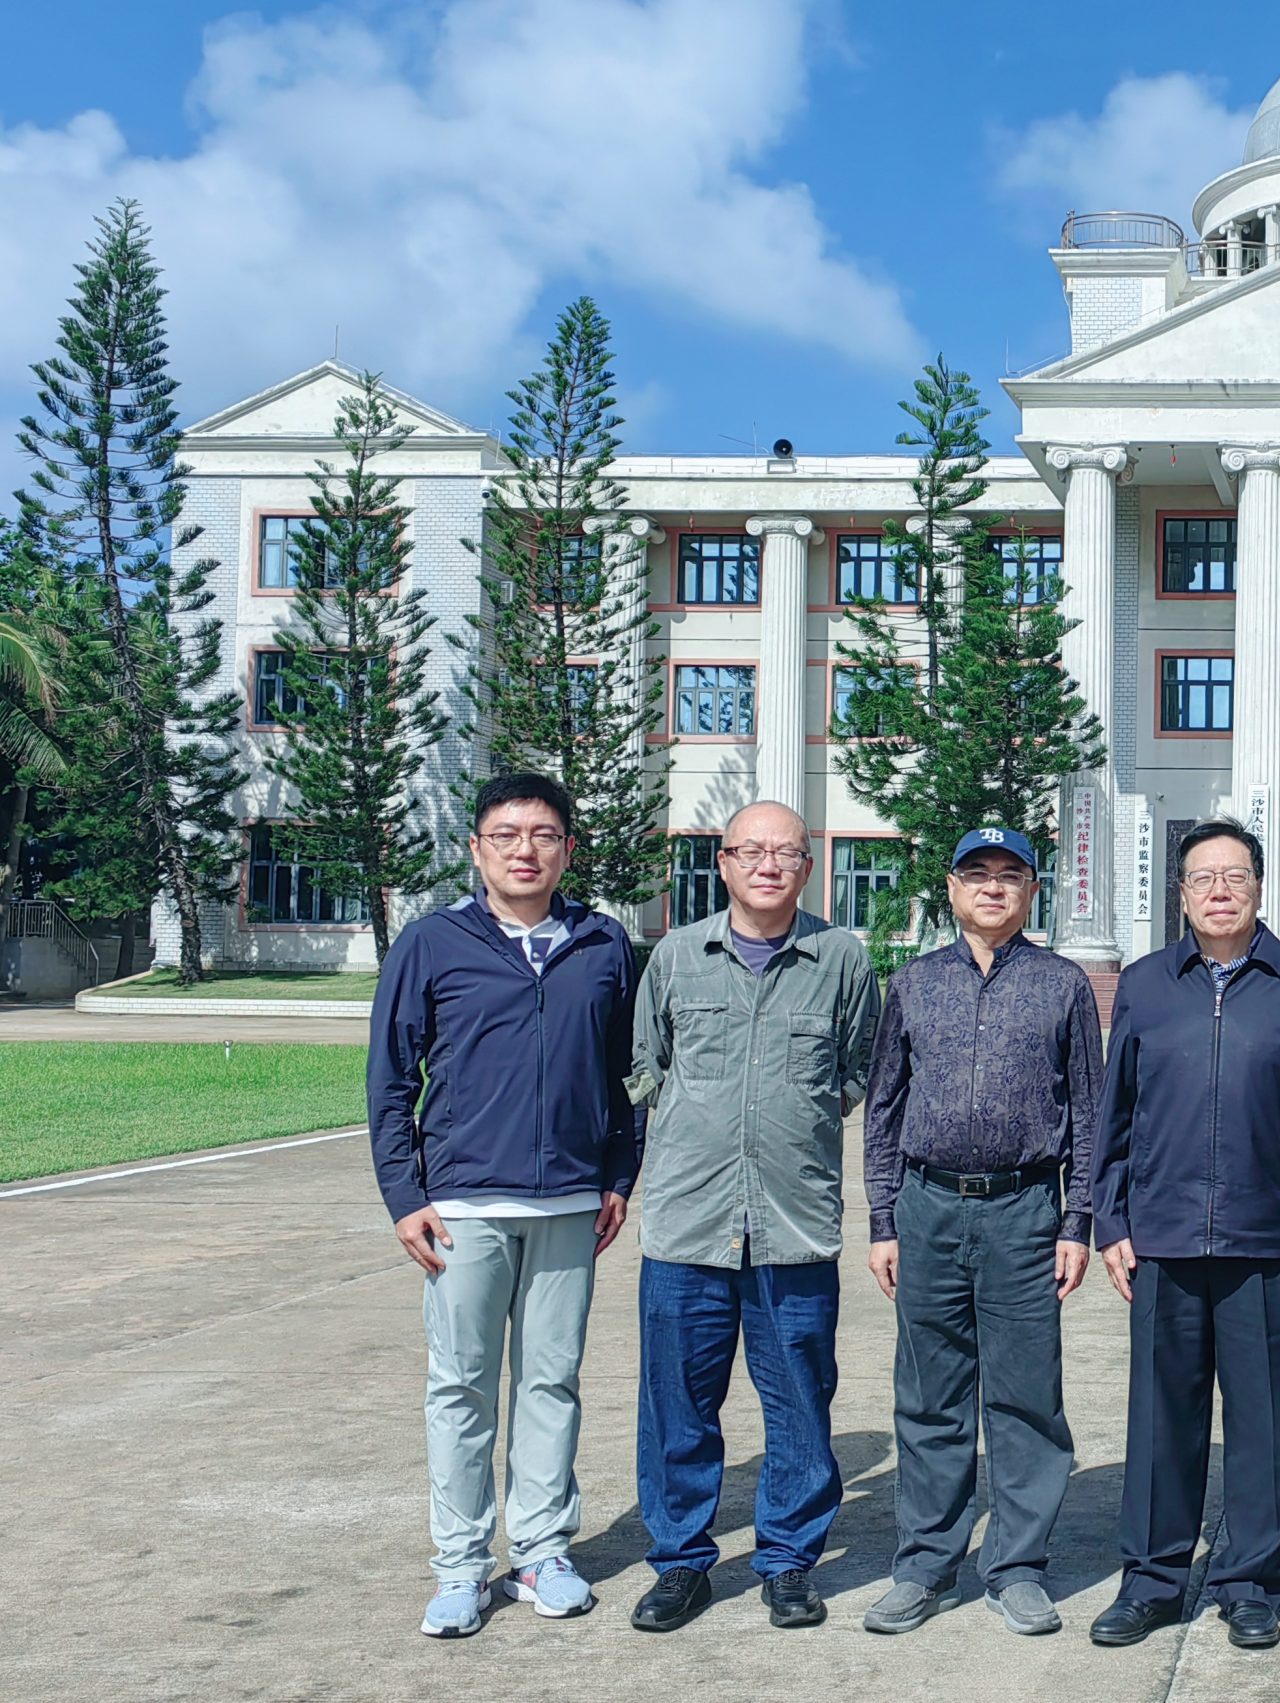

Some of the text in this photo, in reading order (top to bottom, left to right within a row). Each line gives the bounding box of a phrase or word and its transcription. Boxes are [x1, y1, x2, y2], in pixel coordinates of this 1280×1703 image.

[979, 827, 1005, 844] TB
[1077, 831, 1090, 914] 纪律检查委员会
[1138, 810, 1150, 915] 三沙市监察委员会
